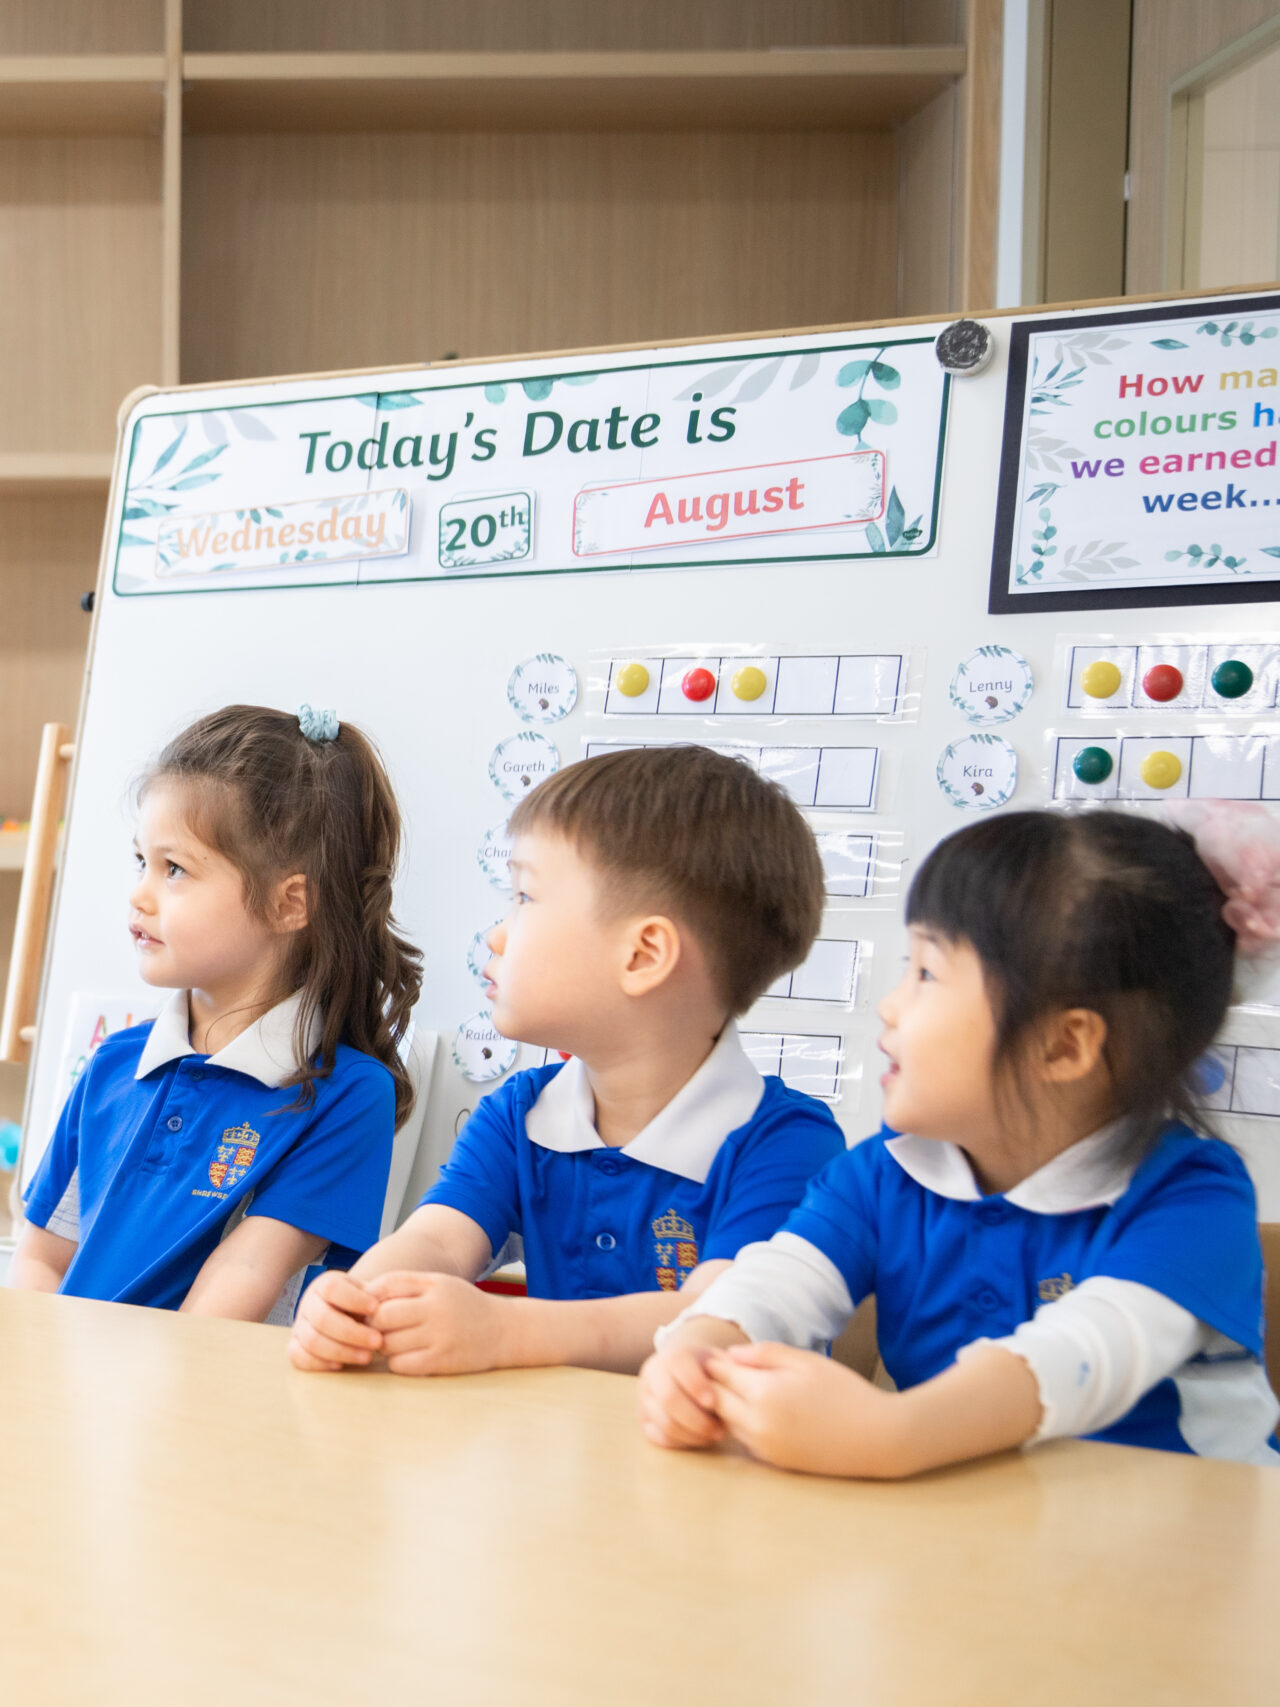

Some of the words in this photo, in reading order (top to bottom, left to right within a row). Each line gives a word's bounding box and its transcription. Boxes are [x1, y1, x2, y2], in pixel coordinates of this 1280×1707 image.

[1118, 374, 1205, 399] How
[1219, 368, 1278, 391] ma
[299, 412, 498, 481] Today's
[521, 406, 661, 457] Date
[686, 392, 737, 444] is
[1093, 411, 1238, 440] colours
[1070, 458, 1125, 479] we
[1139, 441, 1278, 475] earned
[644, 477, 805, 532] August
[176, 507, 386, 559] Wednesday
[445, 505, 525, 552] 20th
[528, 682, 560, 694] Miles
[969, 680, 1012, 693] Lenny
[503, 760, 545, 773] Gareth
[963, 765, 993, 777] Kira
